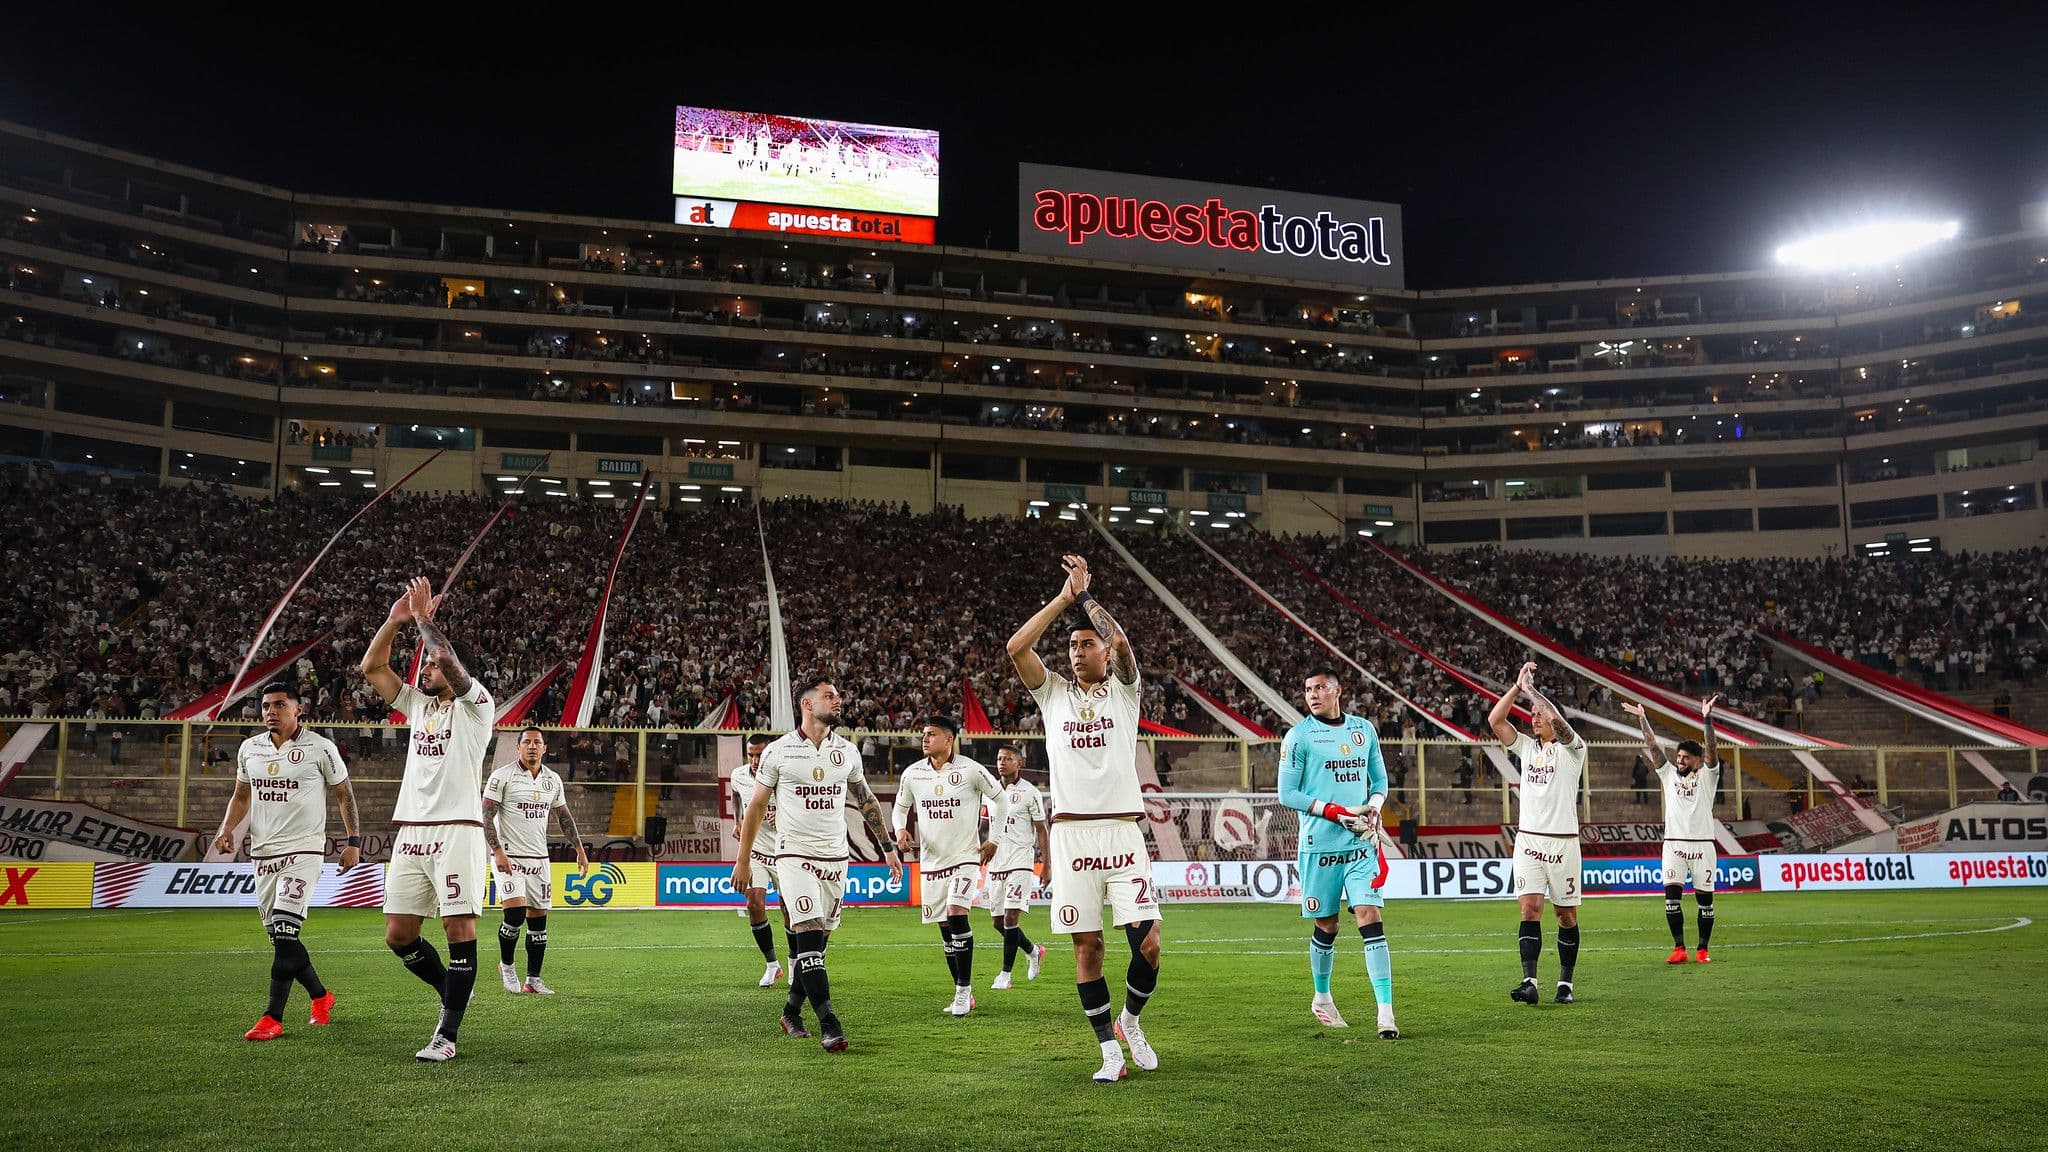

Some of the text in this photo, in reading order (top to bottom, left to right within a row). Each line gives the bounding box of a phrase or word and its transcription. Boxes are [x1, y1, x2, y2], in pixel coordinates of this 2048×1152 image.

[690, 202, 715, 225] at
[768, 210, 902, 236] apuestatotal
[1034, 189, 1391, 266] apuestatotal
[601, 460, 638, 473] SALIDA
[1063, 716, 1114, 735] apuesta
[1071, 733, 1106, 749] total
[1324, 756, 1366, 773] apuesta
[252, 777, 299, 790] apuesta
[1334, 770, 1361, 783] total
[258, 790, 288, 803] total
[795, 783, 841, 797] apuesta
[805, 798, 834, 810] total
[921, 798, 961, 811] apuesta
[928, 808, 953, 820] total
[1634, 823, 1665, 841] COM
[1945, 817, 2048, 842] ALTOS
[71, 815, 186, 862] ETERNO
[648, 837, 721, 858] UNIVERSIT
[1525, 848, 1563, 864] OPALUX
[1072, 852, 1135, 872] OPALUX
[1705, 869, 1712, 883] 2
[1781, 854, 1915, 889] apuestatotal
[1949, 855, 2048, 887] apuestato
[165, 868, 256, 895] Electro
[279, 876, 307, 900] 33
[445, 873, 461, 900] 5
[563, 873, 614, 906] 5G
[954, 877, 972, 895] 17
[1168, 881, 1253, 898] apuestatotal
[1565, 877, 1576, 896] 3
[1006, 884, 1022, 899] 24
[274, 921, 299, 935] klar
[532, 933, 548, 942] kla
[800, 957, 825, 969] kla
